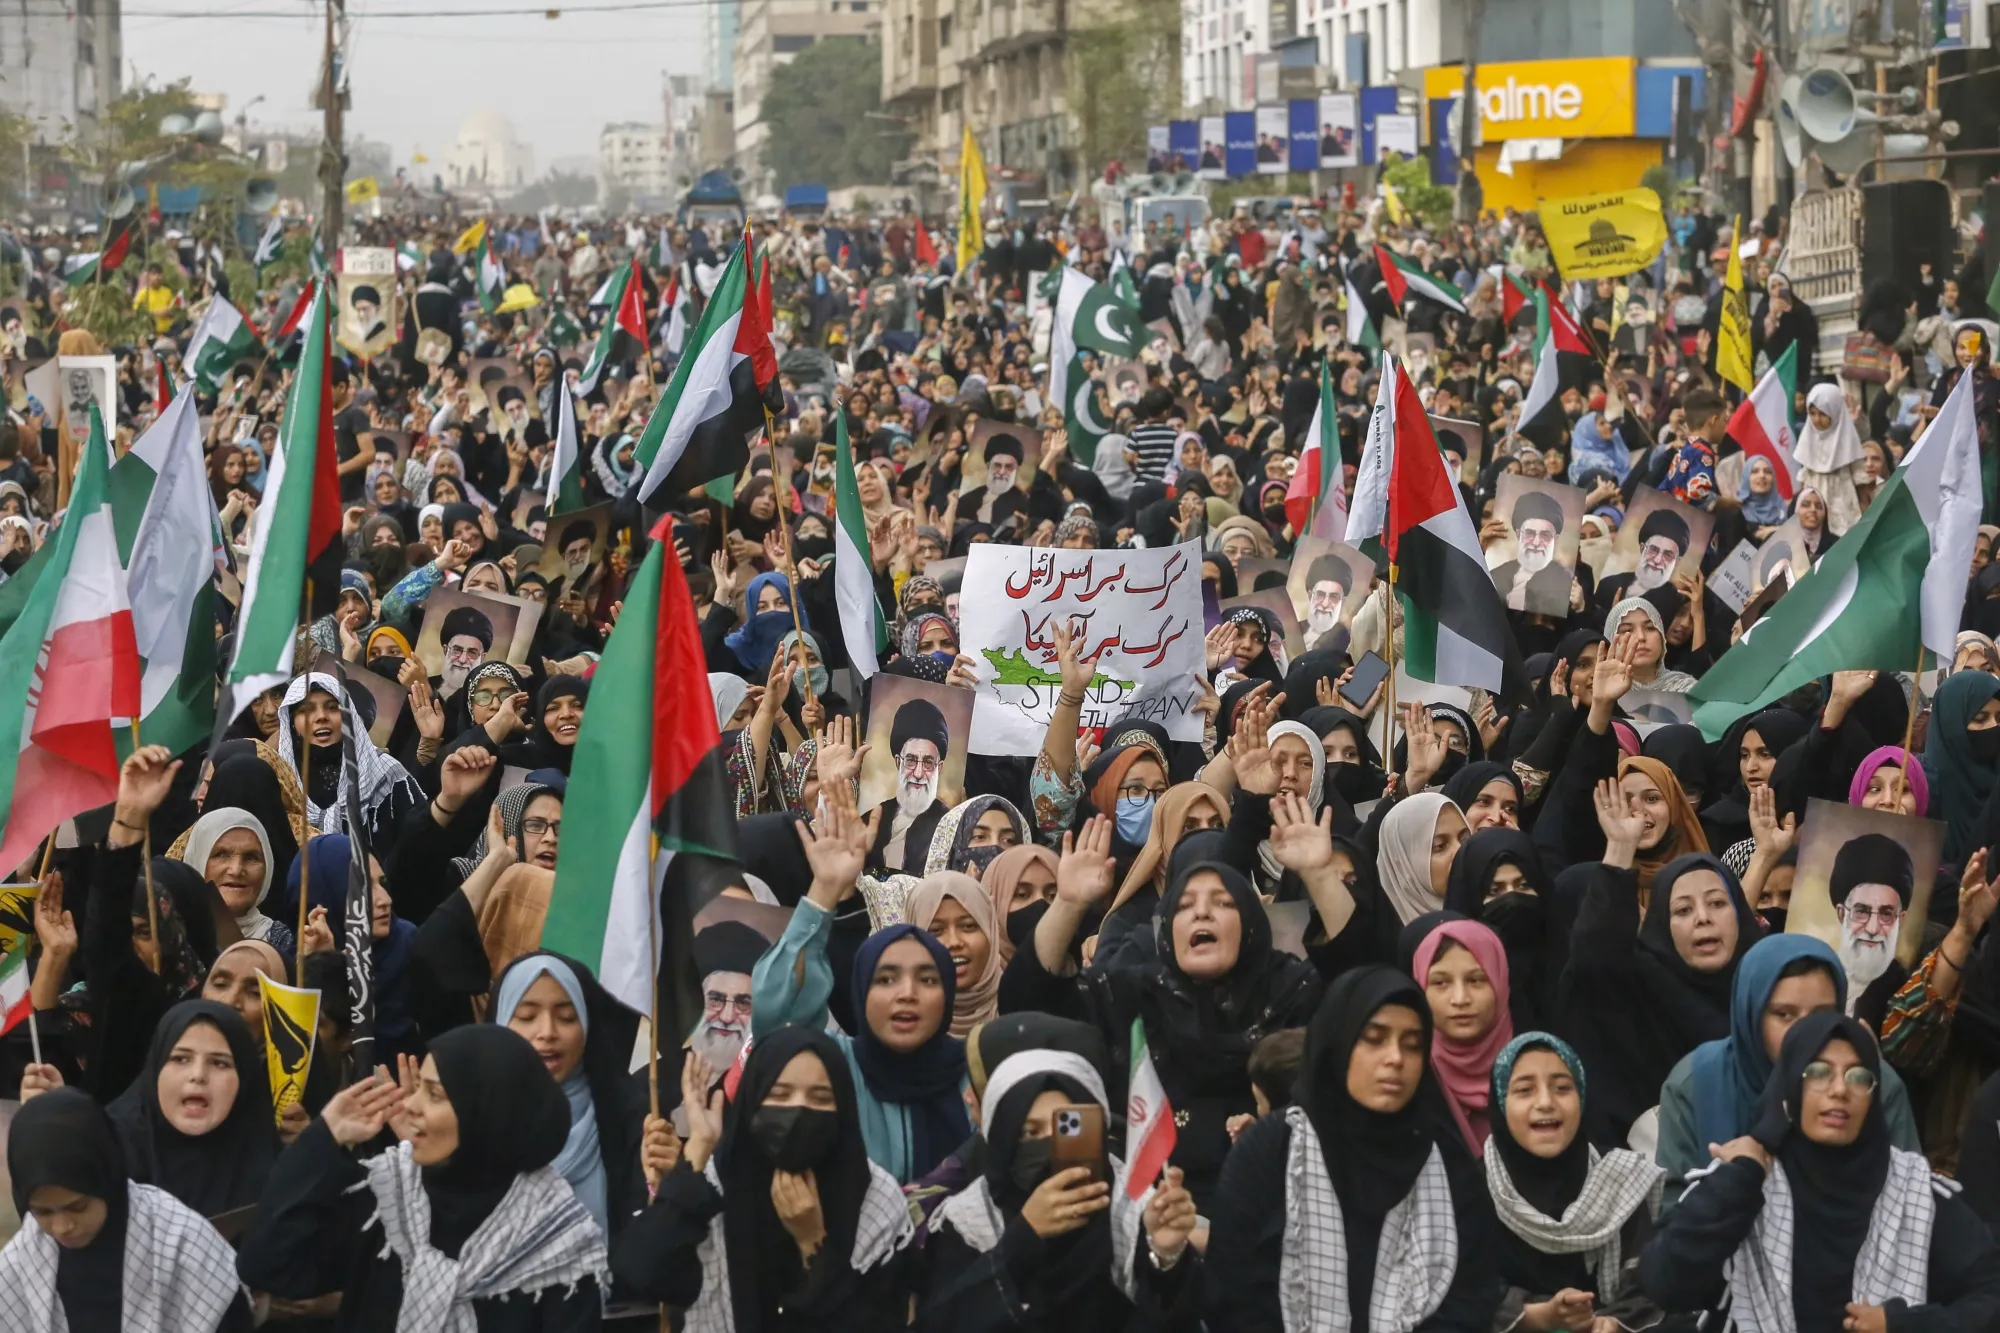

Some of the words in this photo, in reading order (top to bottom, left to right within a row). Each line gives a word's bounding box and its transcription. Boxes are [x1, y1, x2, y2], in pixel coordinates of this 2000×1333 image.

[1005, 546, 1094, 604] اسرائیل
[1074, 563, 1126, 602] بر
[1124, 550, 1188, 611] مرگ
[1079, 624, 1121, 664] بر
[1122, 614, 1188, 668] مرگ
[1021, 676, 1123, 710] STND
